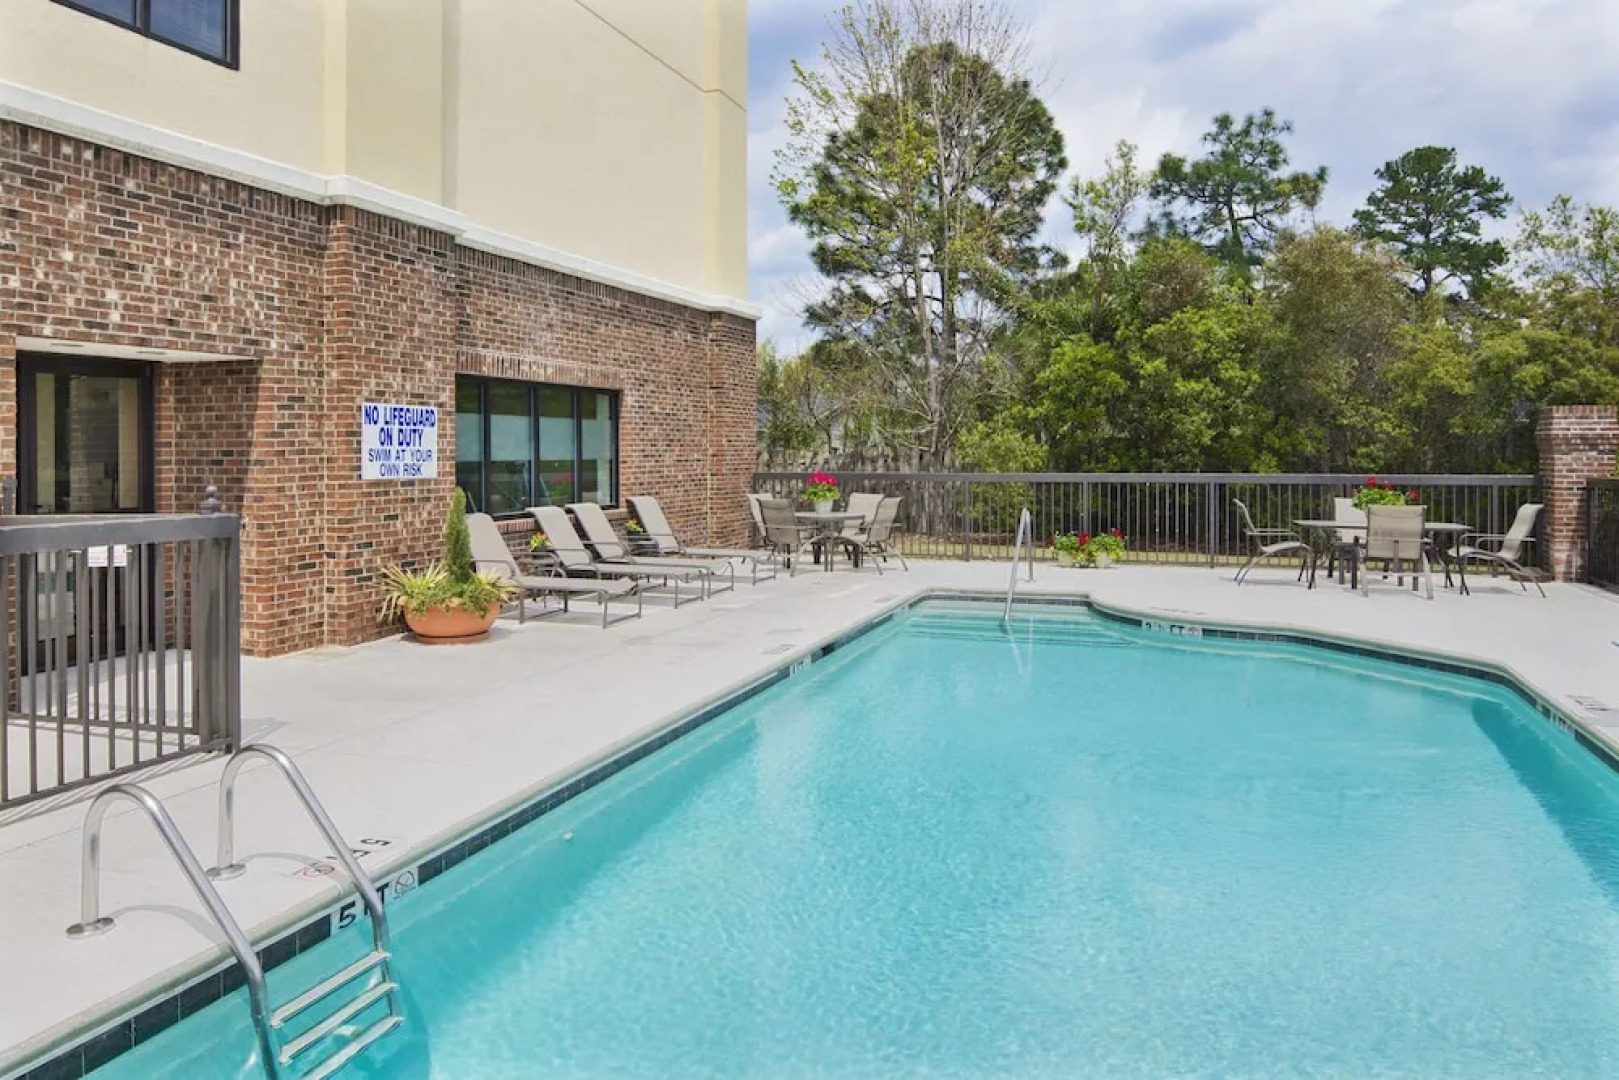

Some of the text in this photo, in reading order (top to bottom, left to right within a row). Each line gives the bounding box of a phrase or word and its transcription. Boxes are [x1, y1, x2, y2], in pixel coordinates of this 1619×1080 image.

[364, 405, 435, 427] NO LIFEGUARD
[379, 427, 424, 447] ON DUTY
[369, 448, 432, 462] SWIM AT YOUR
[380, 463, 423, 476] OWN RISK
[339, 900, 355, 929] 5
